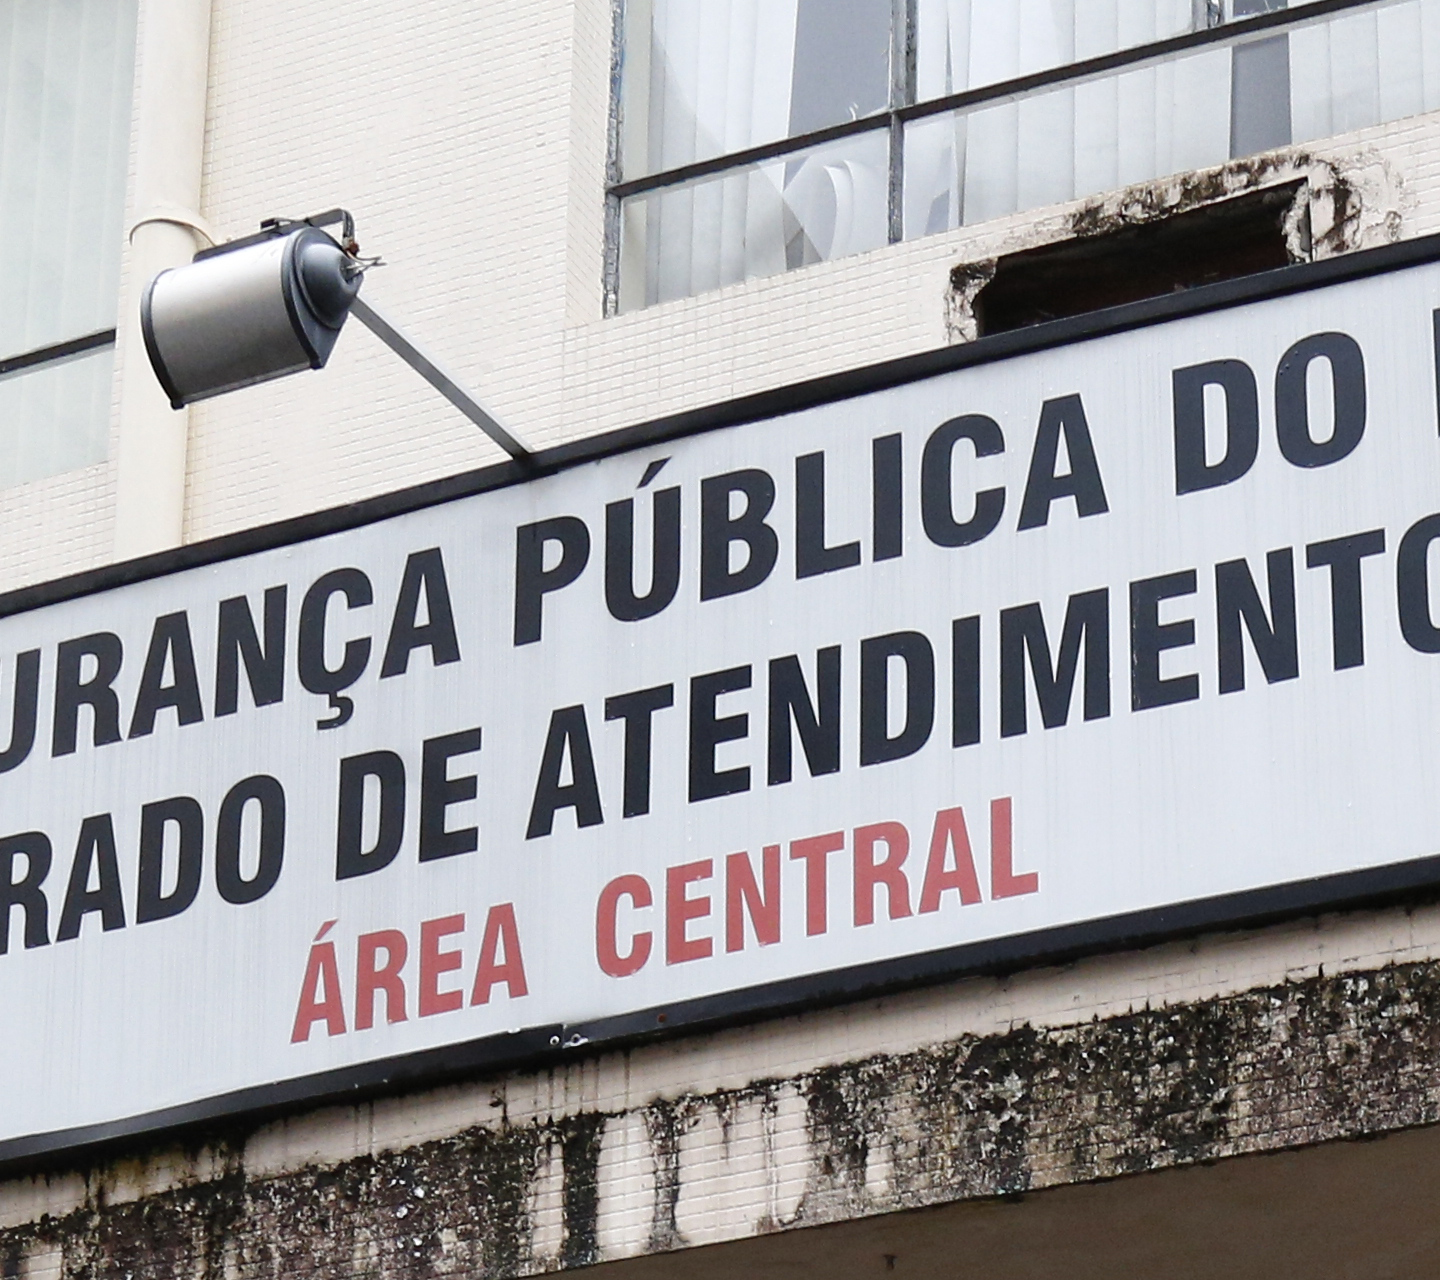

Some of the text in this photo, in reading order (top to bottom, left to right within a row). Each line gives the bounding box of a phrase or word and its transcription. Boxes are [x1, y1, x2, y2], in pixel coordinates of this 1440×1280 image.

[514, 394, 1108, 646] PÚBLICA
[1173, 332, 1366, 495] DO
[293, 799, 1037, 1042] ÁREA CENTRAL
[336, 728, 481, 880] DE
